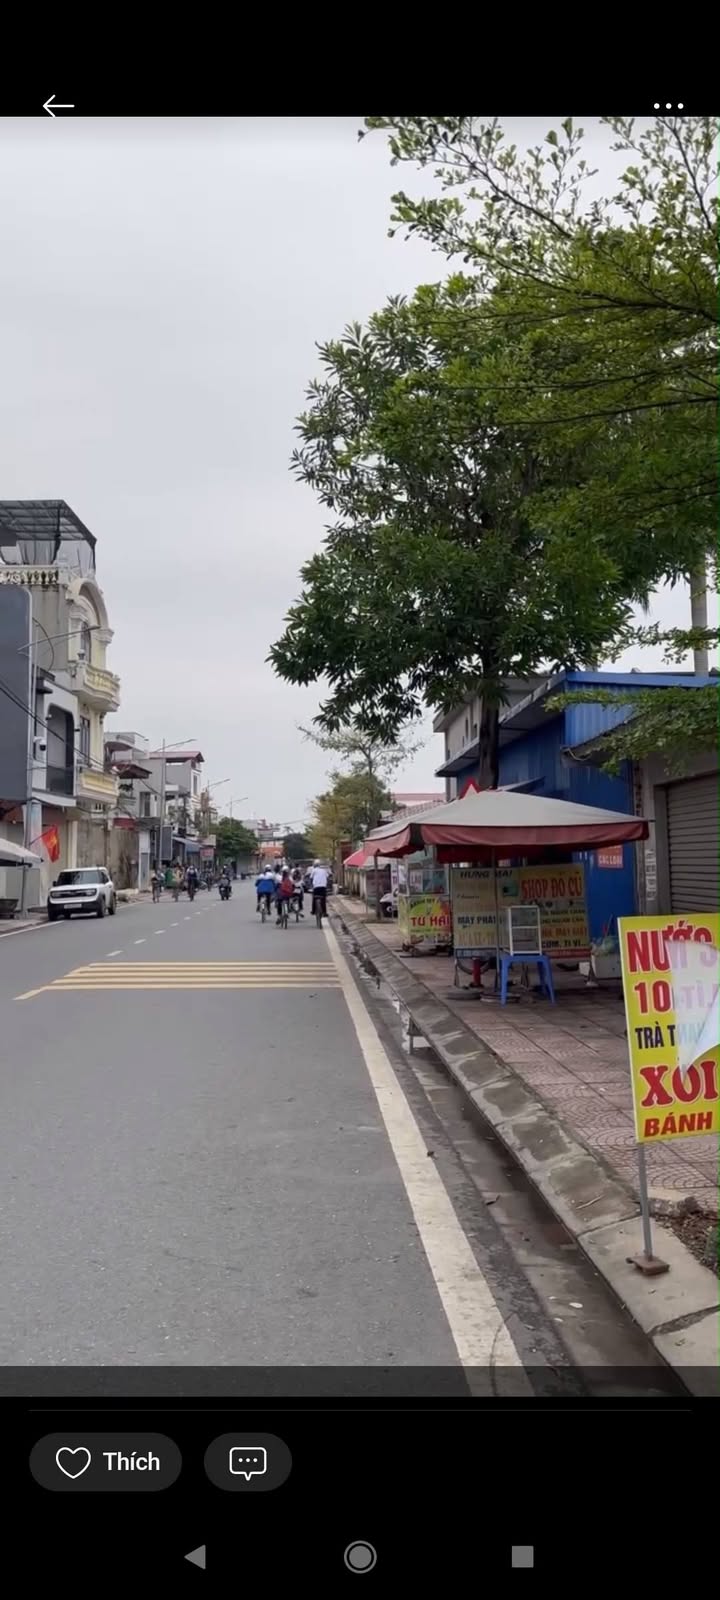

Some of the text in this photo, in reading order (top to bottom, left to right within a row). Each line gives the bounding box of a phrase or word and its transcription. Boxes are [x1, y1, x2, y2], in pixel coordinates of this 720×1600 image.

[521, 879, 548, 898] SHOP
[634, 1021, 665, 1050] TRÀ
[644, 1112, 713, 1138] BÁNH
